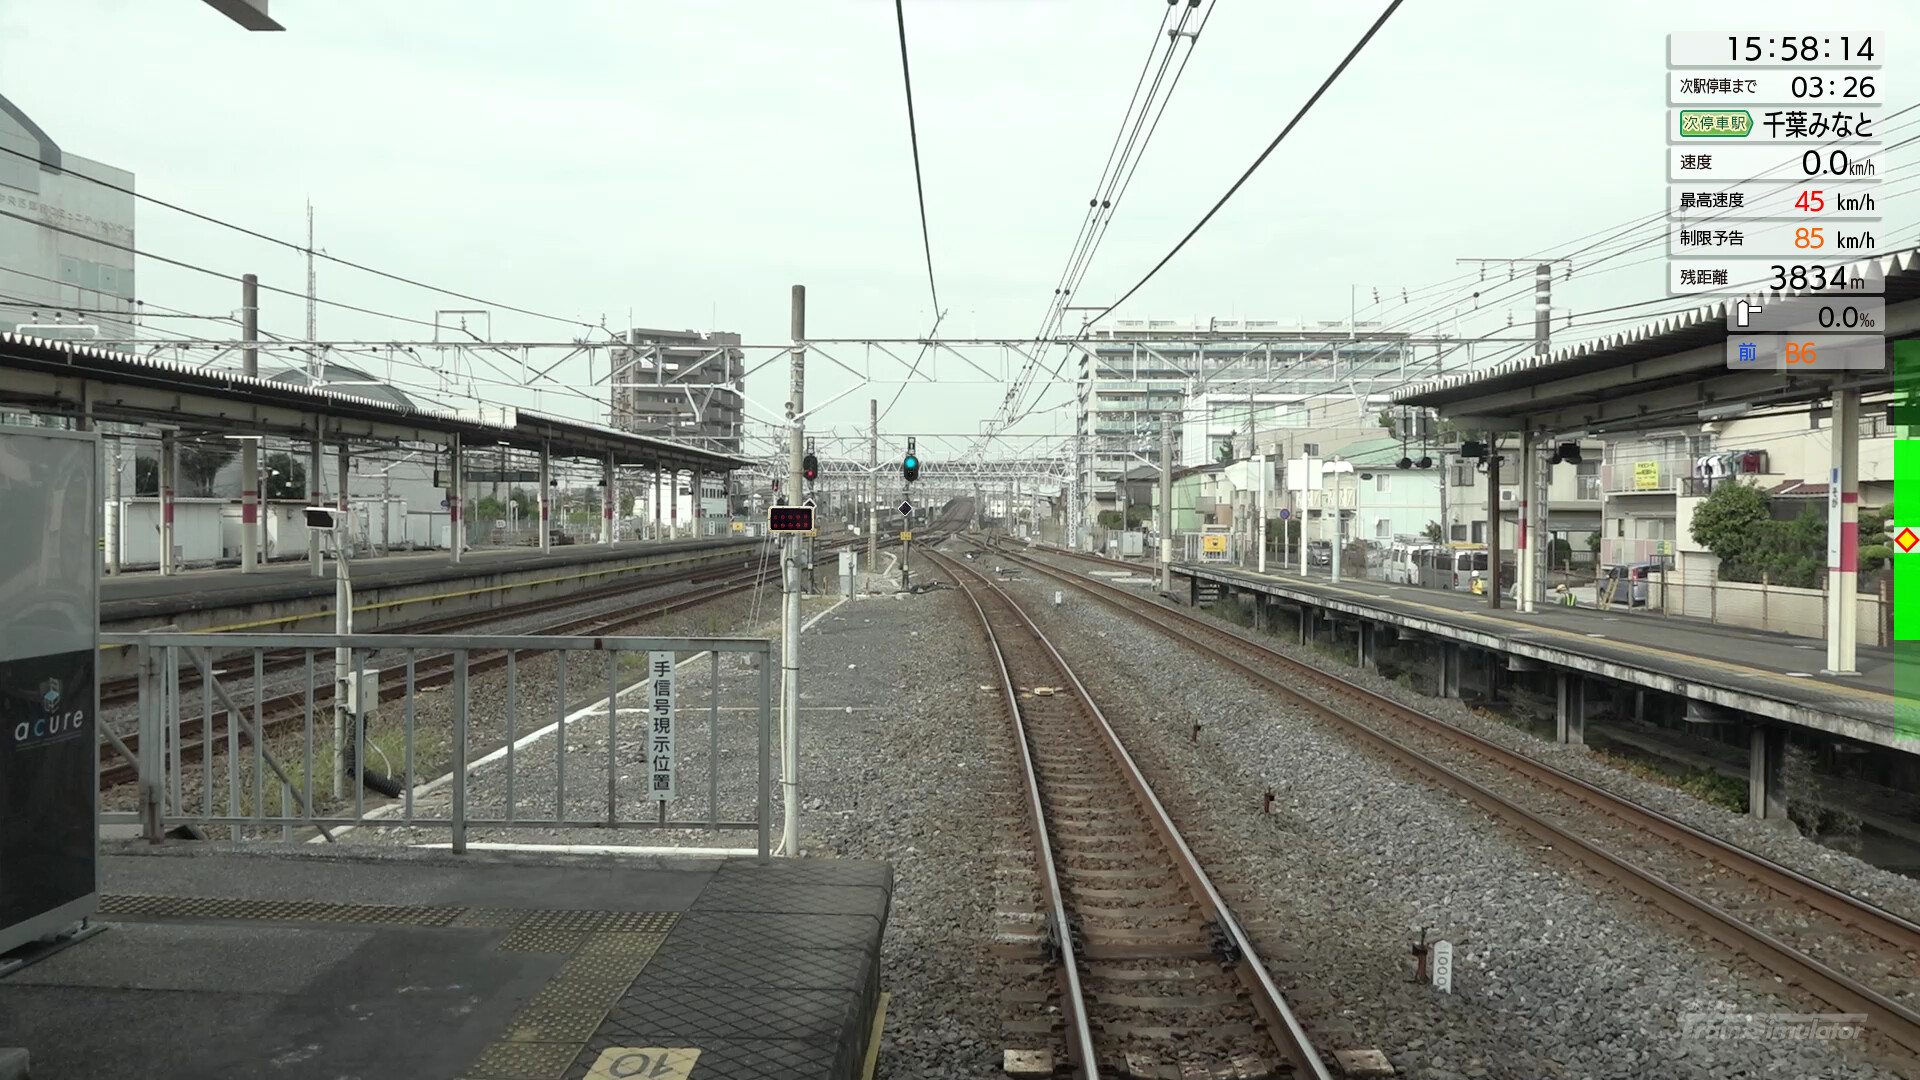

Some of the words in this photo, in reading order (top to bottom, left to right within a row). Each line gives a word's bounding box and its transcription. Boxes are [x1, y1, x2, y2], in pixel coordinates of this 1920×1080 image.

[14, 710, 84, 741] acure
[653, 660, 671, 791] 手信号現示位置
[609, 1053, 673, 1078] 10
